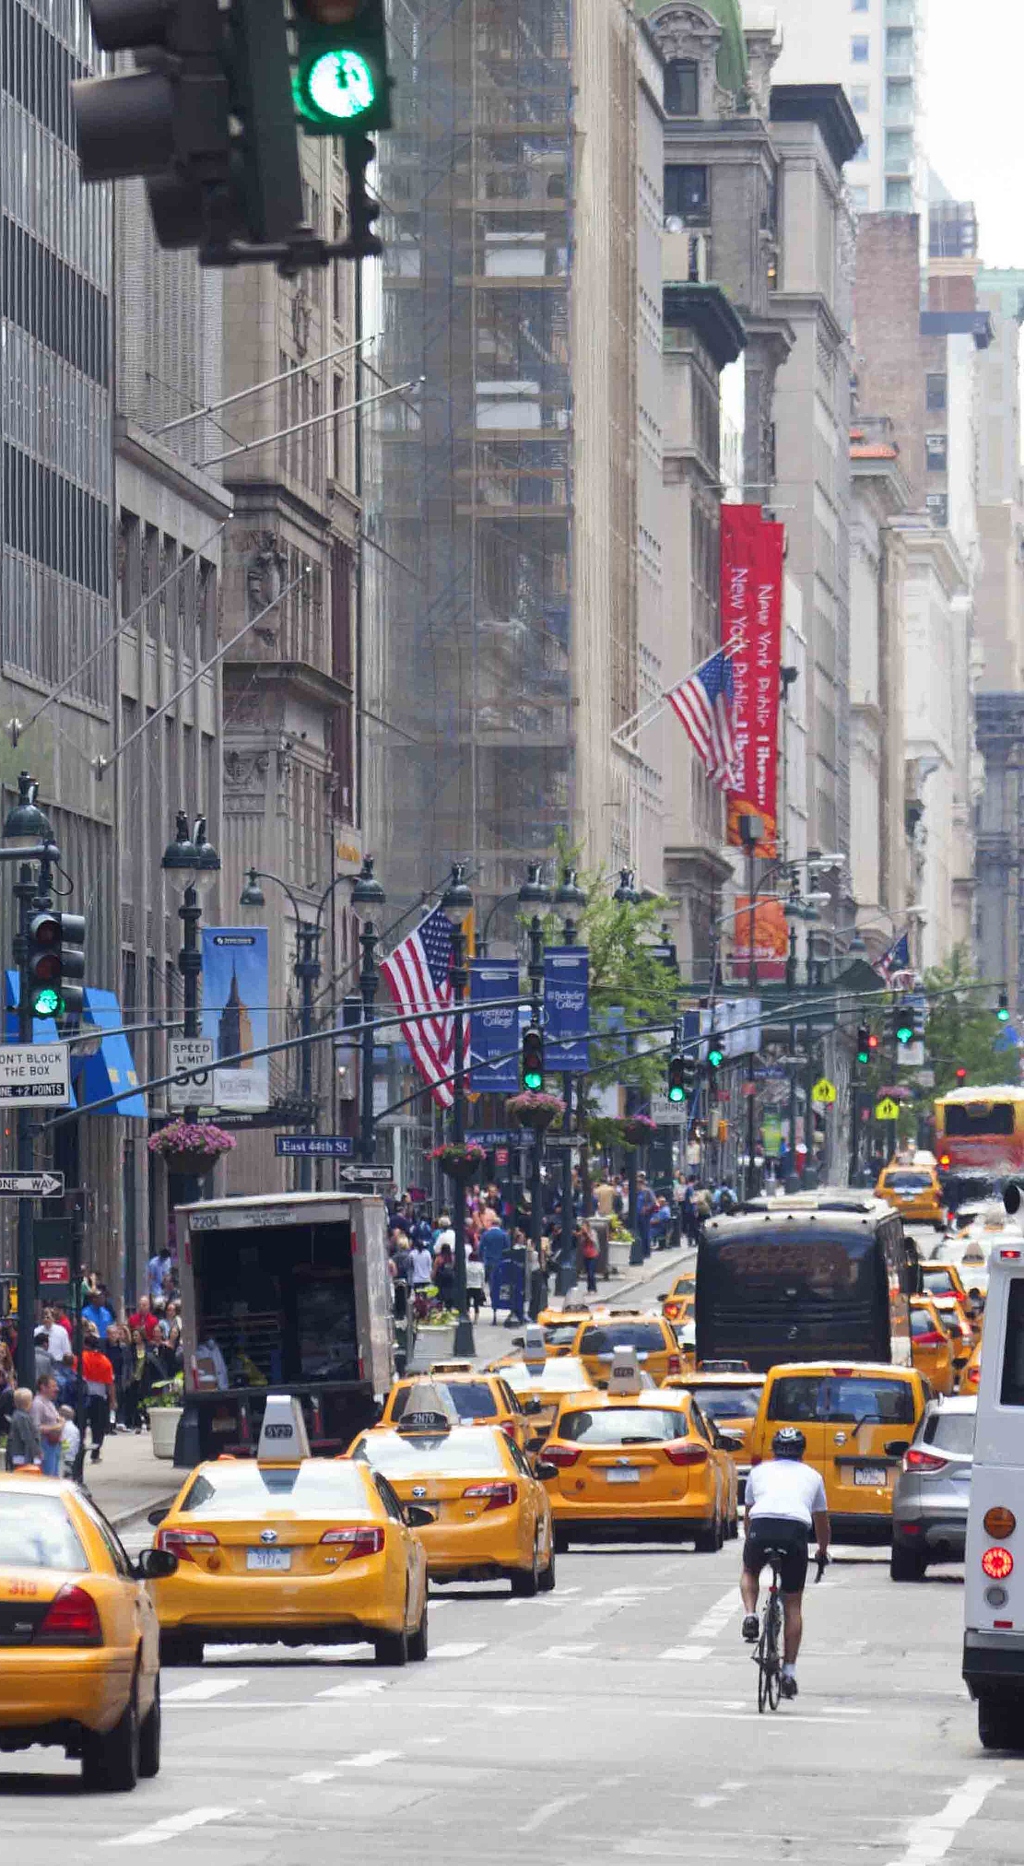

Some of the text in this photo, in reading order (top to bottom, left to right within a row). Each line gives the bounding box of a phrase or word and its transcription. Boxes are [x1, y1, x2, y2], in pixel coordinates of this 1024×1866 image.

[730, 568, 748, 610] New
[556, 1000, 584, 1012] College
[483, 1016, 514, 1029] College
[172, 1044, 210, 1054] SPEED
[26, 1053, 62, 1064] BLOCK
[177, 1056, 204, 1064] LIMIT
[4, 1066, 50, 1077] THE BOX
[16, 1086, 29, 1096] +2
[32, 1084, 62, 1096] POINTS
[281, 1140, 348, 1152] East 44th St
[31, 1178, 55, 1190] WAY
[192, 1214, 220, 1229] 2204
[413, 1412, 436, 1423] 2N70
